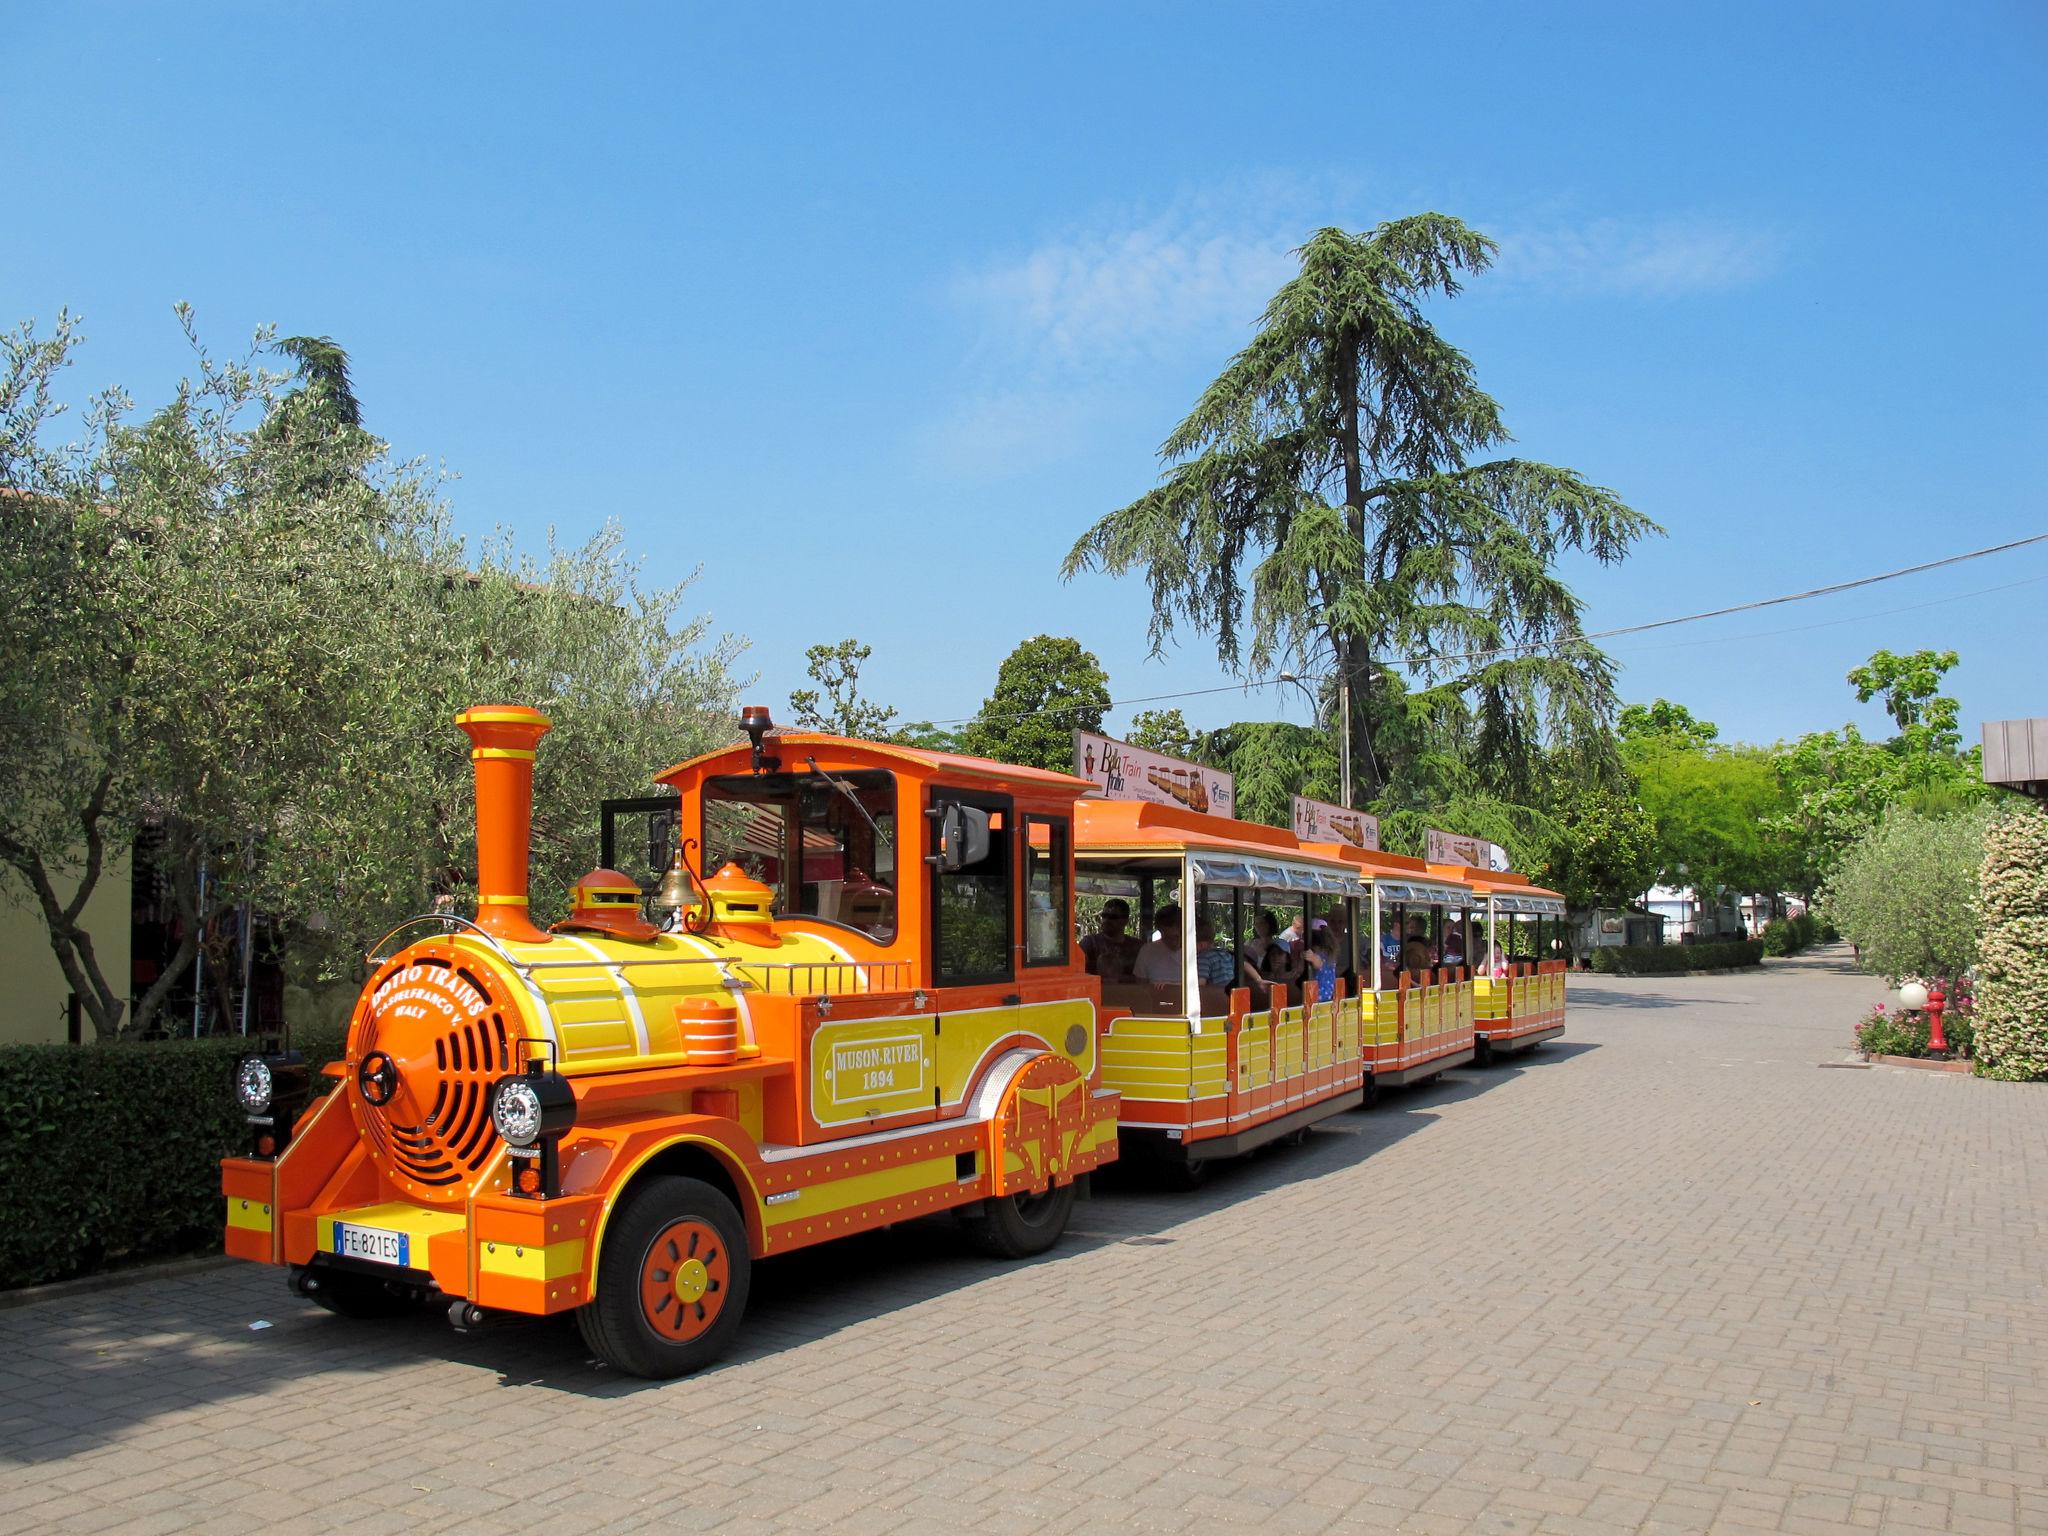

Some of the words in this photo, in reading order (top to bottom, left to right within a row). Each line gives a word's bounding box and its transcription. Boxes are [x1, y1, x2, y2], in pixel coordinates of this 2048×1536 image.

[1122, 755, 1141, 778] Train
[372, 966, 422, 1008] DOTTO
[427, 966, 485, 1016] TRAINS
[376, 988, 454, 1017] CASTELFRANCO
[394, 1005, 427, 1019] ITALY
[863, 1069, 894, 1090] 1894
